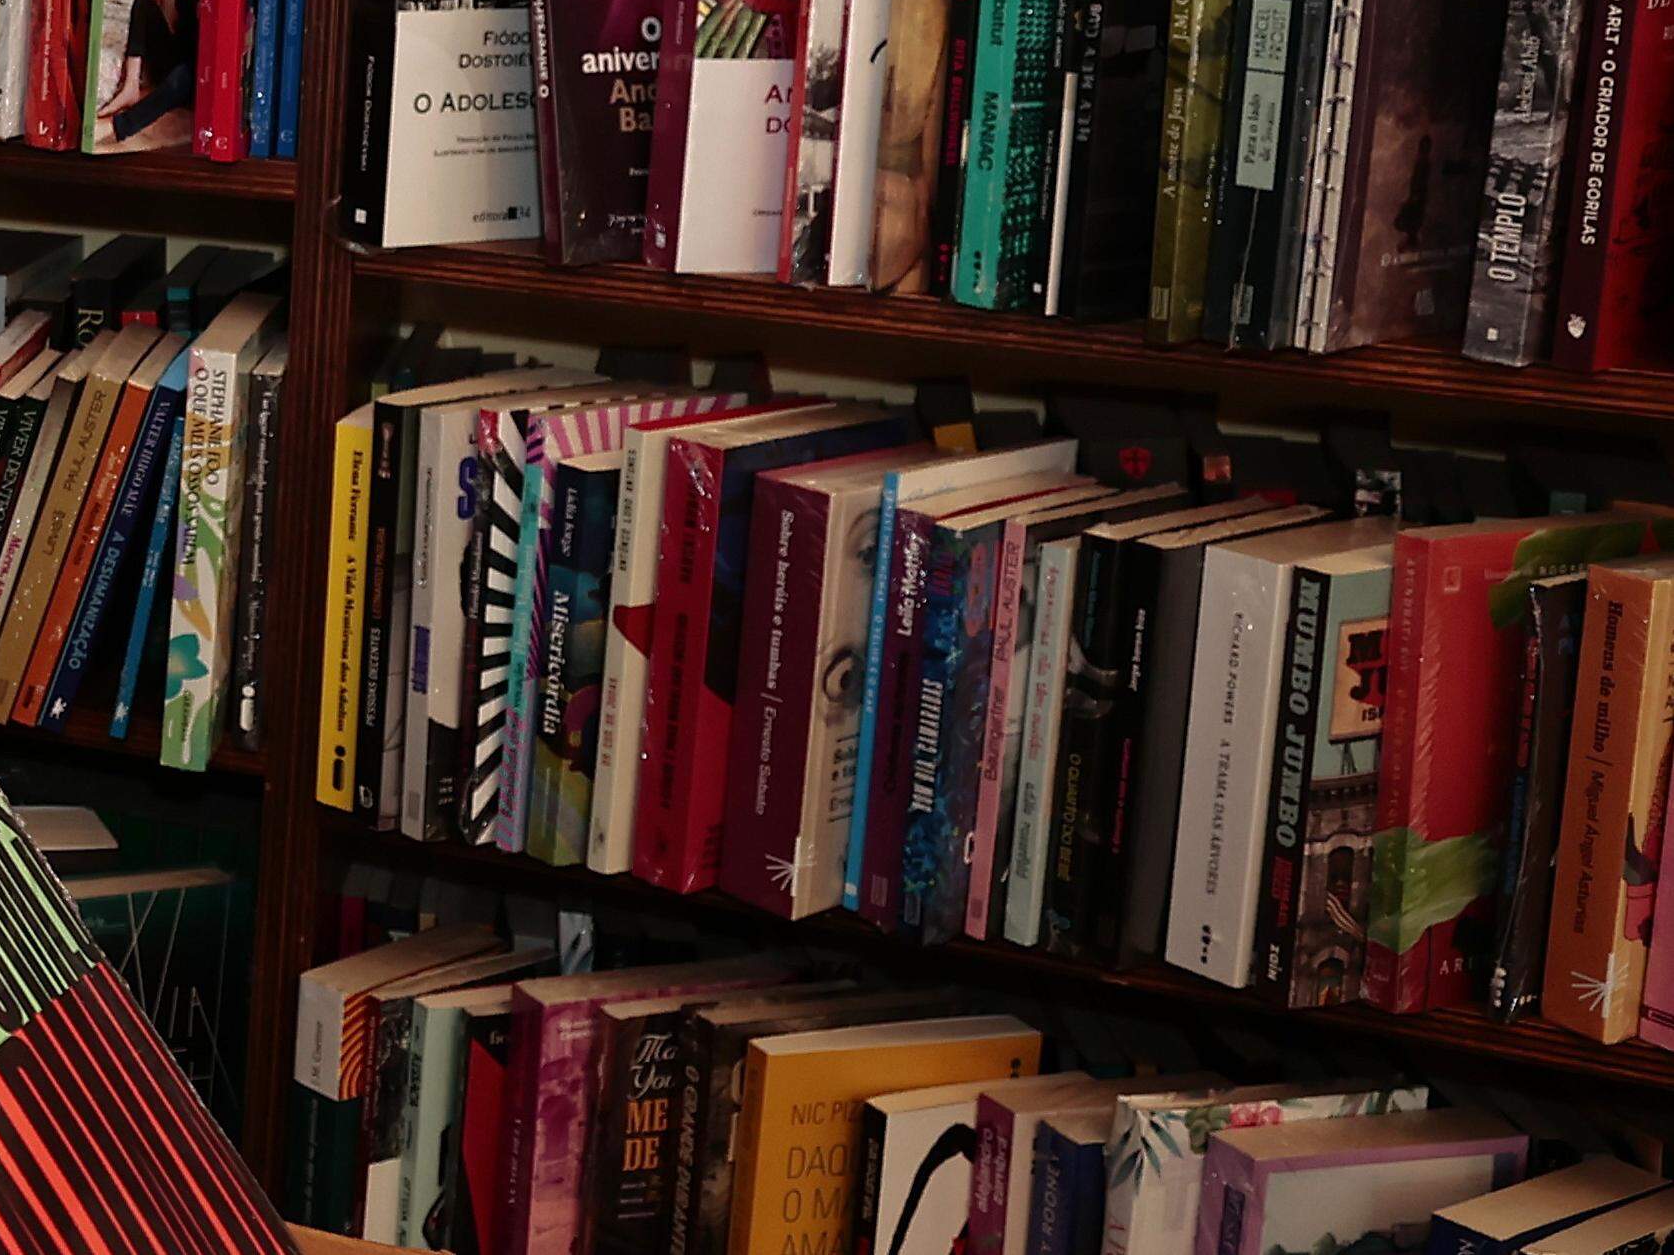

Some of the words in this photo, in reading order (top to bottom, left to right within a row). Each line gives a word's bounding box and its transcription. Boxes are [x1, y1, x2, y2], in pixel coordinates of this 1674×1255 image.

[641, 16, 661, 41] O
[1171, 9, 1190, 41] J.M.
[1605, 5, 1624, 44] ARLT
[1601, 59, 1616, 71] O
[413, 93, 431, 113] O
[538, 85, 550, 98] O
[1168, 87, 1184, 121] Jesus
[978, 91, 998, 171] MANIAC
[1169, 124, 1181, 140] de
[1592, 77, 1615, 148] CRIADOR
[1166, 144, 1180, 182] morte
[1589, 152, 1606, 172] DE
[1163, 186, 1176, 198] A
[1580, 177, 1604, 245] GORILAS
[1489, 191, 1526, 261] TEMPLO
[1489, 267, 1515, 281] O
[195, 367, 209, 380] O
[191, 387, 208, 417] QUE
[11, 411, 37, 458] VIVER
[190, 419, 205, 461] MEUS
[349, 450, 366, 487] Elena
[346, 490, 362, 542] Ferrante
[778, 510, 796, 556] Sobre
[343, 567, 356, 593] Vida
[772, 560, 792, 611] heróis
[68, 547, 121, 671] DESUMANIZAÇÃO
[339, 595, 354, 661] Mentirosa
[896, 597, 915, 635] Leila
[1288, 576, 1321, 716] MUMBO
[1599, 601, 1625, 673] Homens
[337, 663, 350, 683] dos
[540, 590, 573, 735] Misericórdia
[766, 629, 784, 689] tumbas
[1598, 676, 1616, 694] de
[335, 685, 349, 733] Adultos
[1590, 698, 1613, 753] milho
[758, 706, 778, 761] Ernesto
[755, 765, 773, 815] Sabato
[1275, 724, 1309, 848] JUMBO
[792, 1103, 826, 1127] NIC
